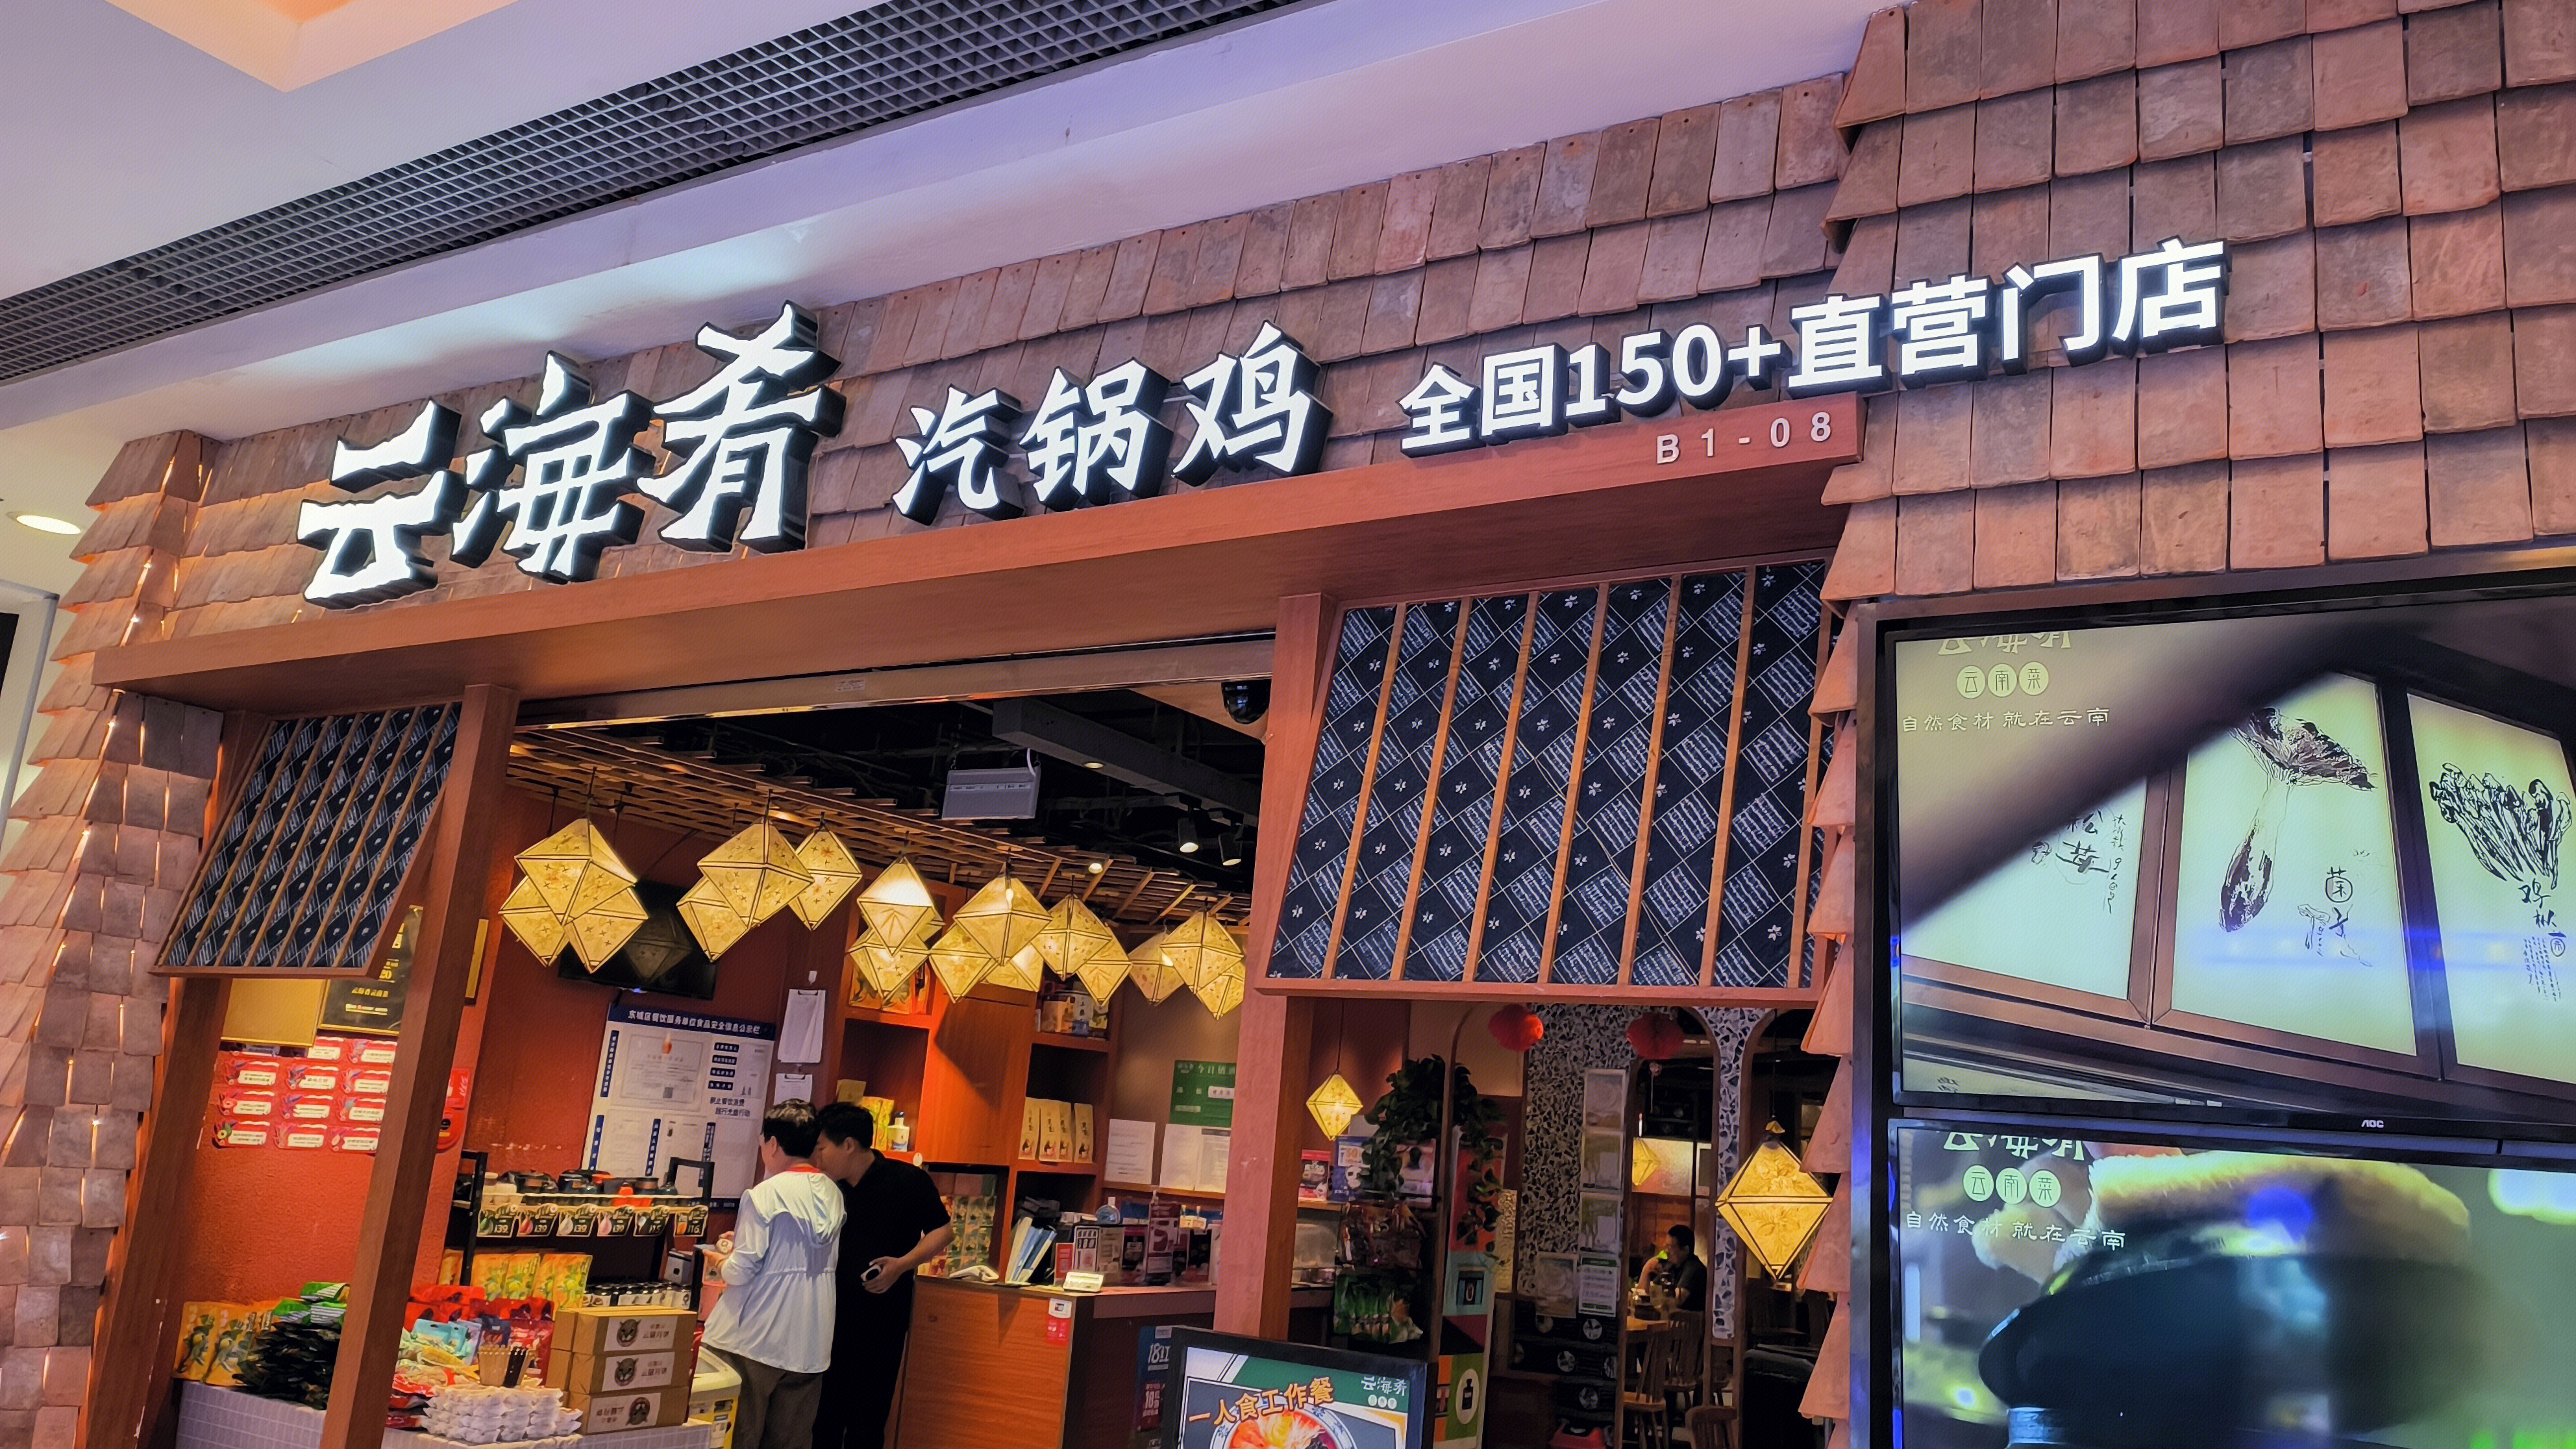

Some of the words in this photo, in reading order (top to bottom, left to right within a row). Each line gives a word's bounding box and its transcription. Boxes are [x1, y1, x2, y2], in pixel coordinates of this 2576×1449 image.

[1400, 238, 2225, 451] 全国150+直营门店
[892, 321, 1311, 515] 汽锅鸡
[1657, 412, 1831, 464] B1-08
[297, 301, 828, 602] 云海肴
[1961, 665, 2044, 695] 云南菜
[2361, 1119, 2384, 1128] AOC
[1968, 1169, 2056, 1204] 云南菜
[1189, 1376, 1334, 1426] 一人食工作餐
